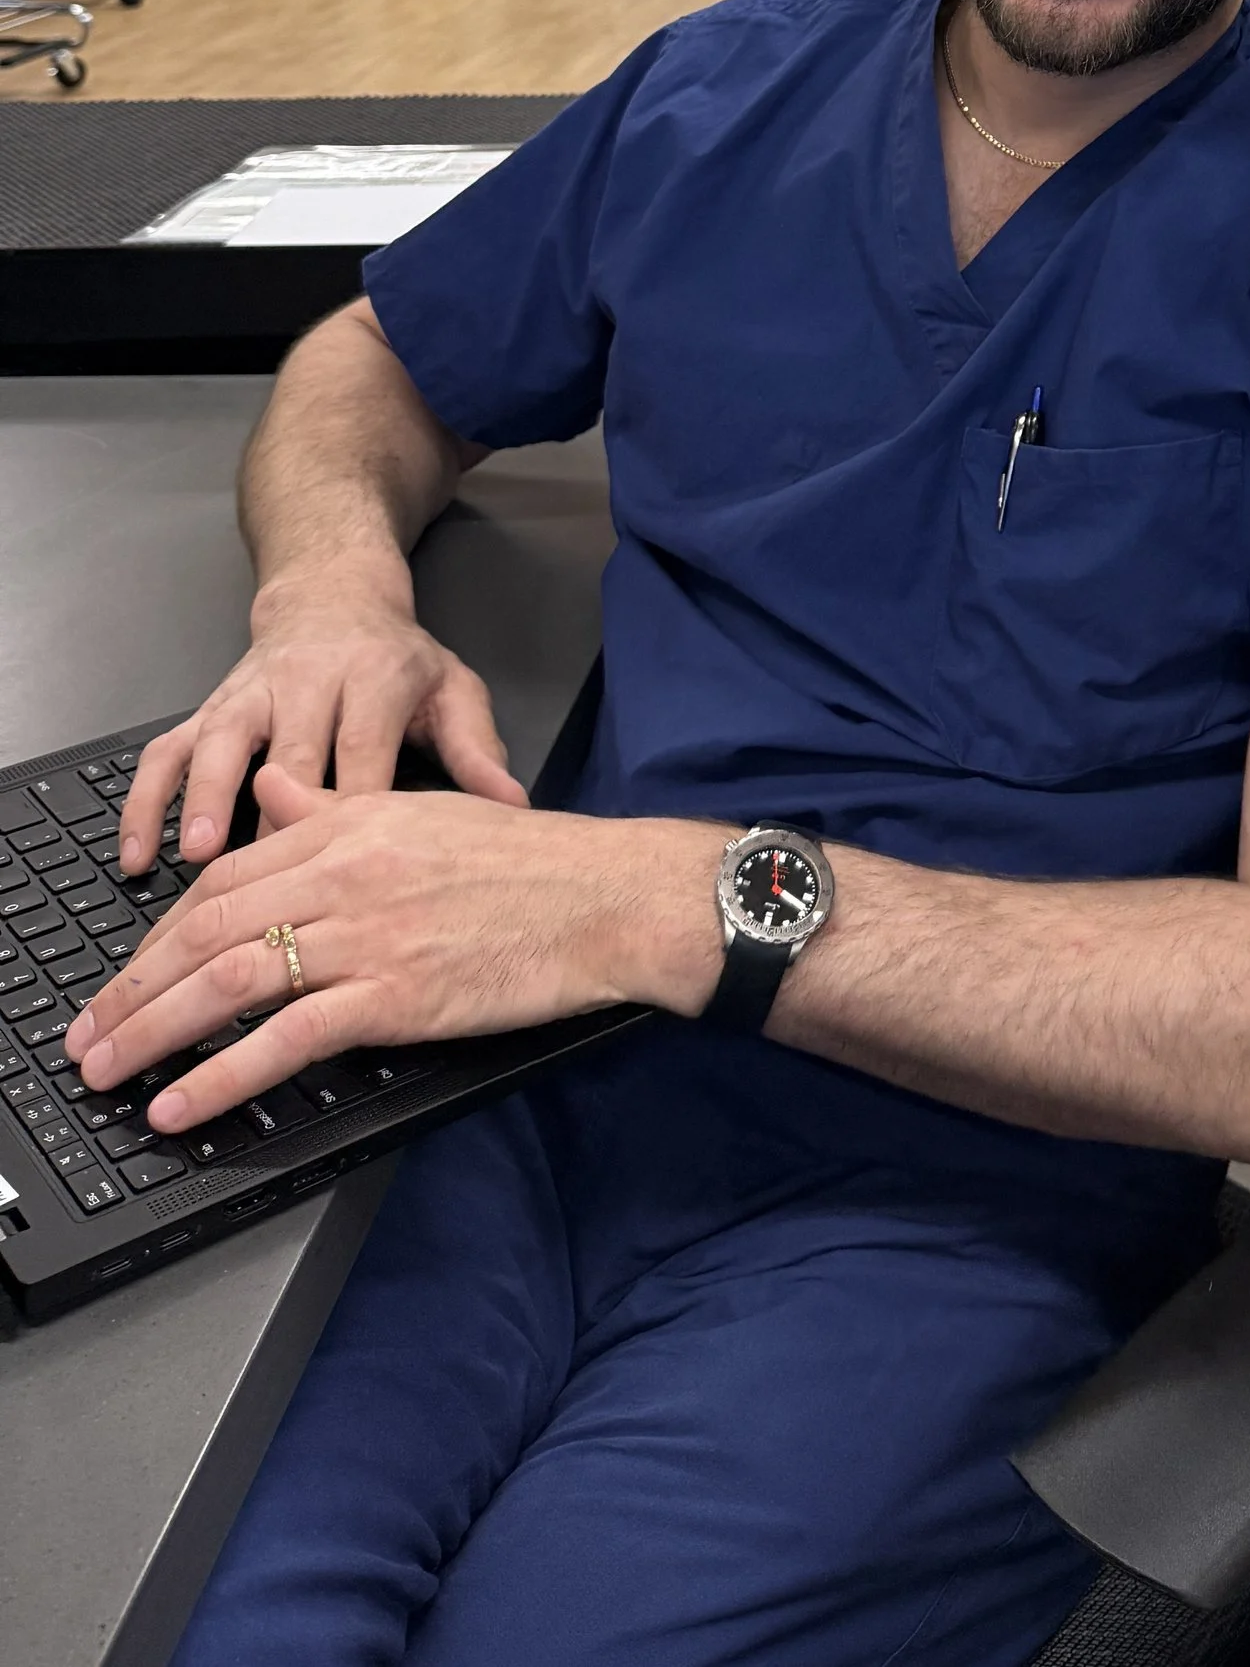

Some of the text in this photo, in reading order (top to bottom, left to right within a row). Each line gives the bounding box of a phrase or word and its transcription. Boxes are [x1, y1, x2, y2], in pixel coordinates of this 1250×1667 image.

[112, 945, 127, 953] H
[52, 1022, 67, 1031] 5
[116, 1105, 131, 1113] 2
[92, 1115, 107, 1123] @
[202, 1144, 214, 1156] Tab
[86, 1193, 100, 1205] Esc
